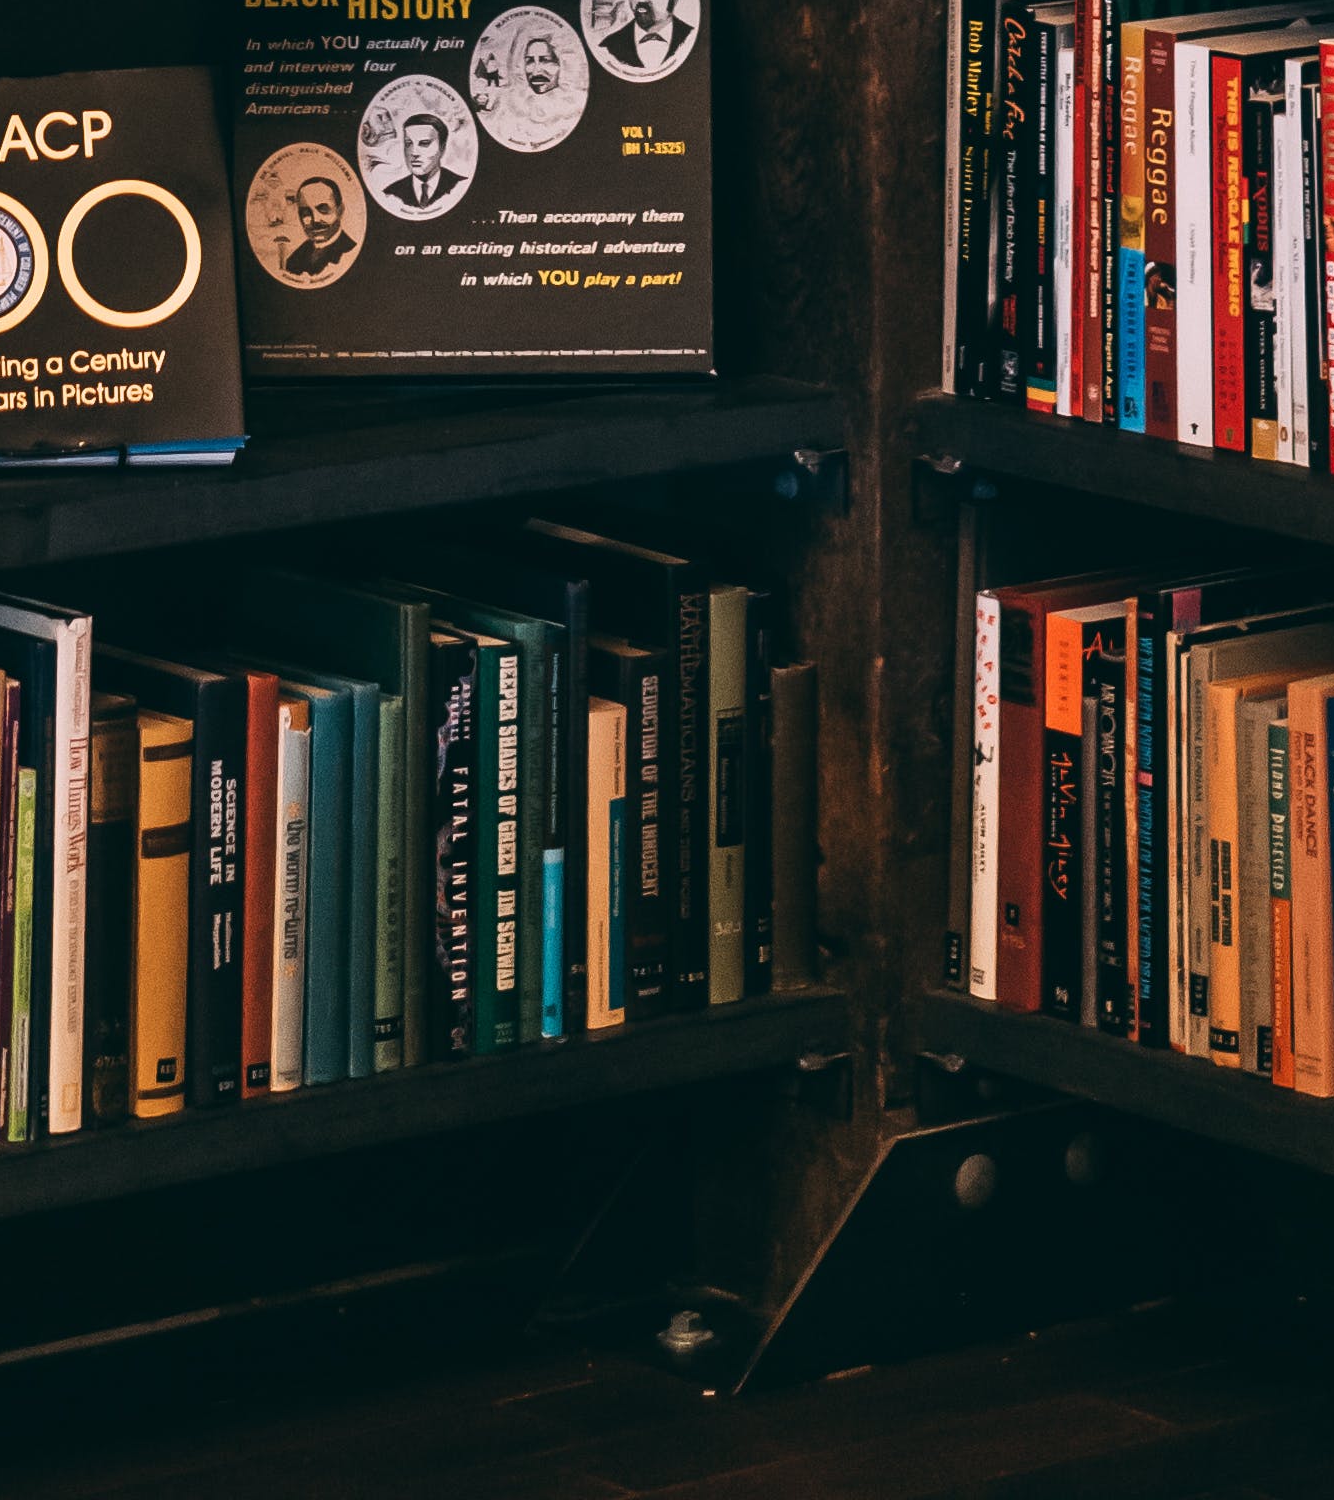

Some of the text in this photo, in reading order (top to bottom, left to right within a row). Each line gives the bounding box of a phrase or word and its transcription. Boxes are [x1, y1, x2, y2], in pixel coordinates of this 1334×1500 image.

[1146, 108, 1173, 225] Reggae
[543, 210, 635, 229] accompany
[641, 209, 685, 225] them
[394, 240, 685, 259] on an exciting historical adventure
[460, 270, 682, 289] in which YOU play a part!
[46, 359, 62, 375] a
[69, 348, 166, 377] Century
[33, 386, 54, 409] in
[61, 381, 154, 408] Pictures
